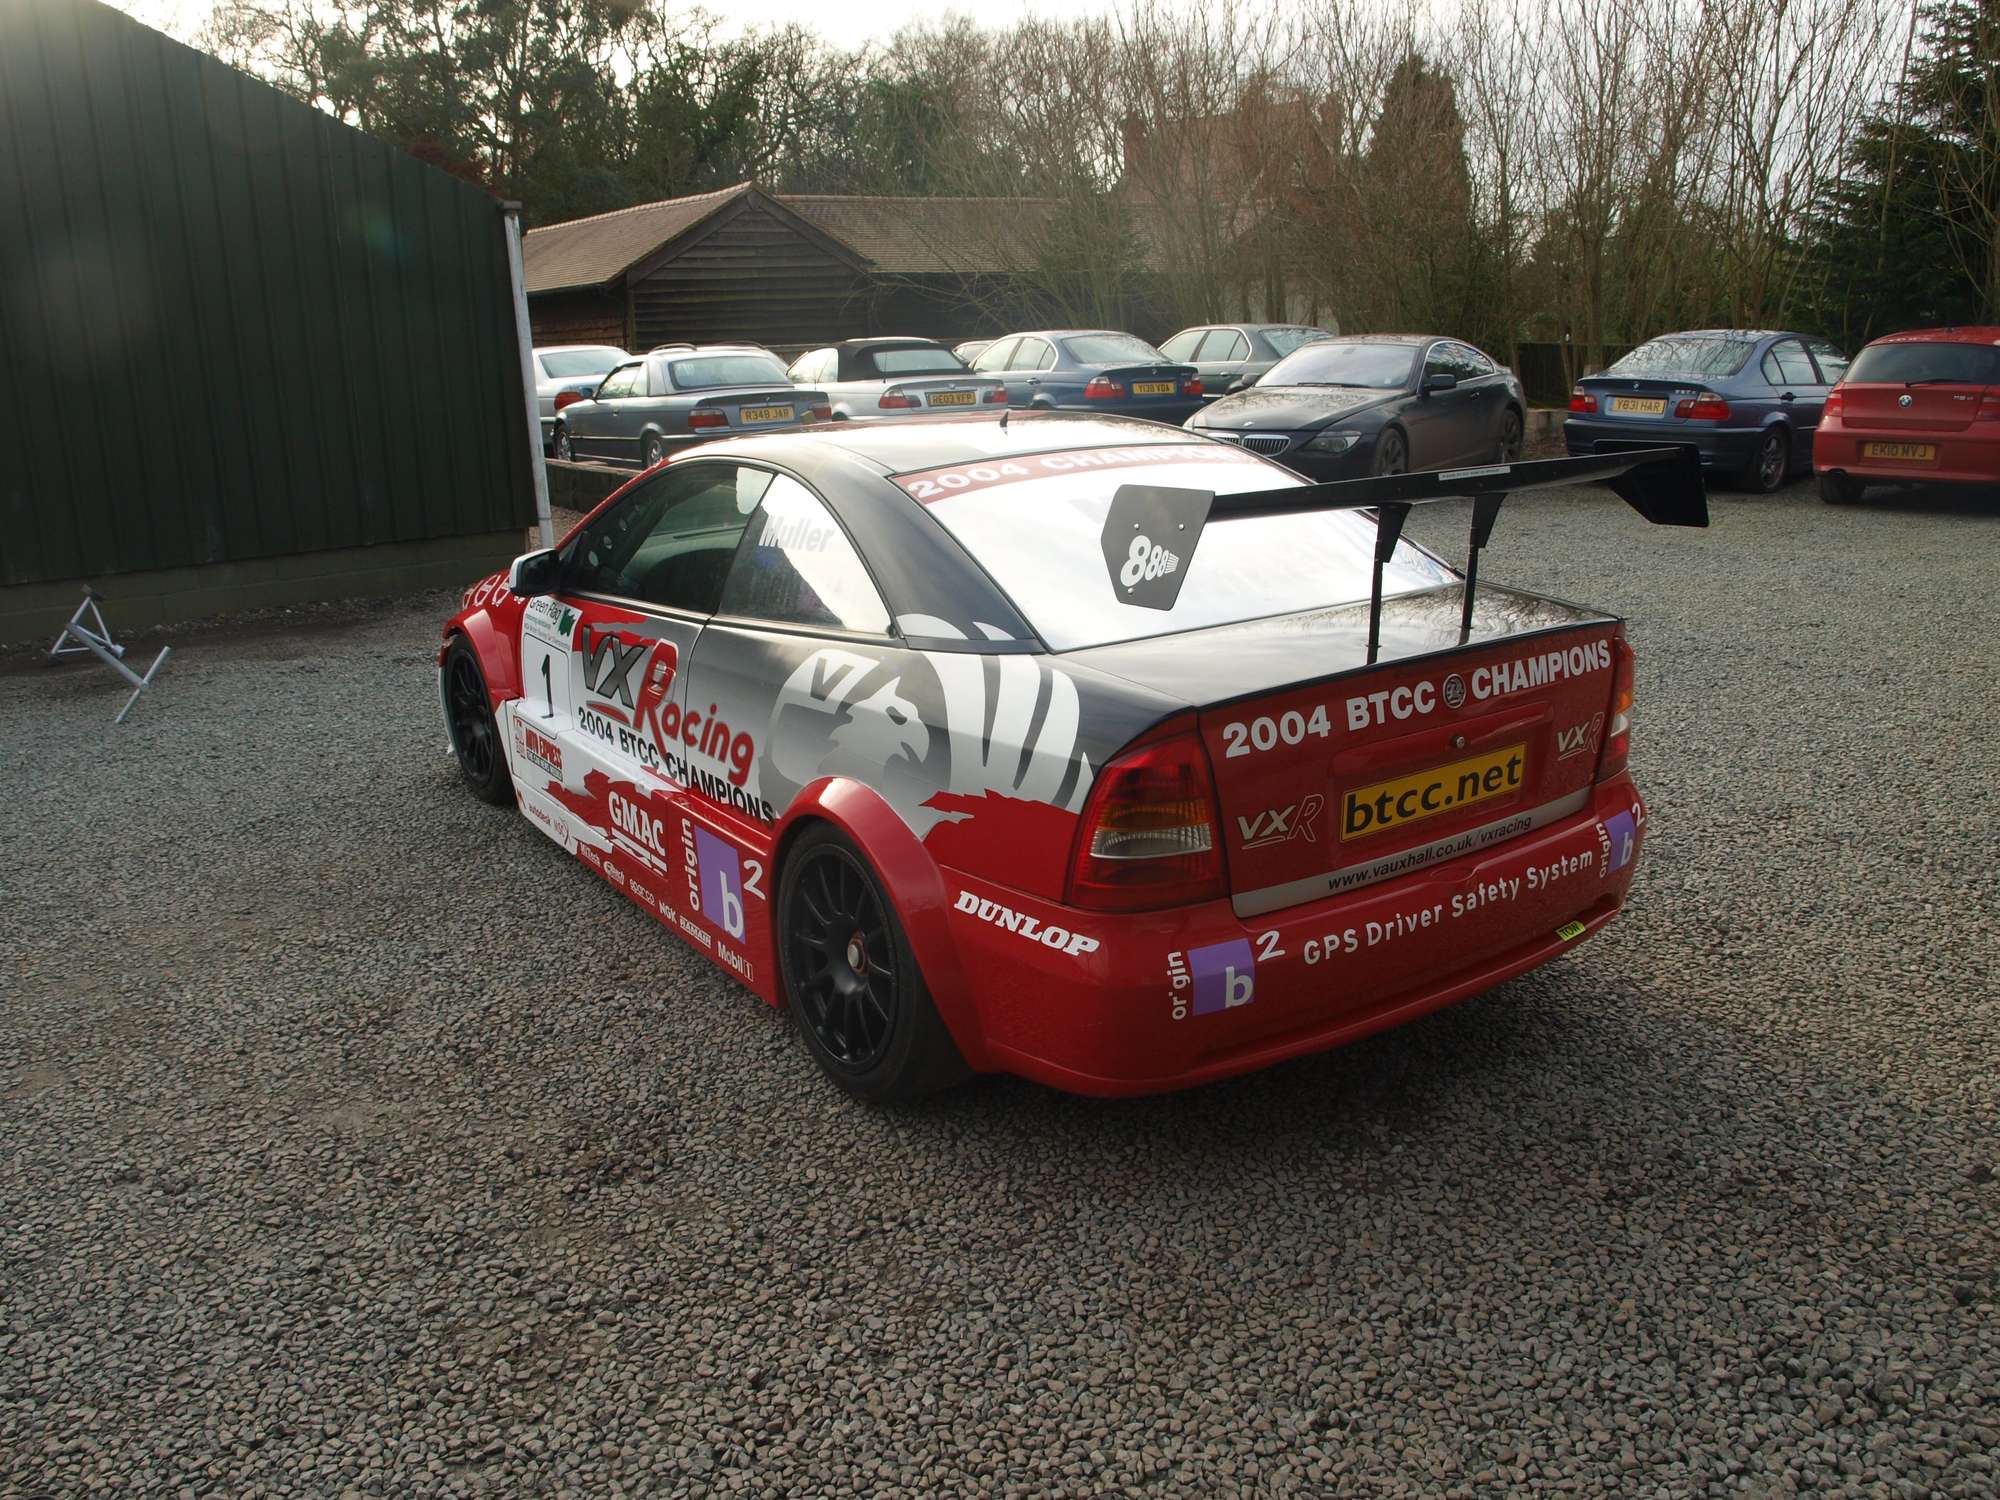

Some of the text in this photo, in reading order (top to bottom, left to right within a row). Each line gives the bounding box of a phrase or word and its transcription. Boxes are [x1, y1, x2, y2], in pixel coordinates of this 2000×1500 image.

[906, 461, 1029, 499] 2004
[540, 654, 554, 719] 1
[1222, 639, 1611, 759] 2004 BTCC CHAMPIONS
[578, 706, 615, 746] 2004
[619, 727, 660, 770] BTCC
[665, 752, 775, 826] CHAMPIONS
[1557, 711, 1605, 756] VXR
[608, 790, 667, 857] GMAC
[1237, 793, 1325, 844] VXR
[1345, 753, 1522, 834] btcc.net
[681, 818, 700, 911] origin
[658, 900, 678, 924] NGK
[717, 940, 744, 974] Mobil
[953, 889, 1101, 957] DUNLOP
[1303, 850, 1594, 965] GPS Driver Safety System
[1560, 921, 1582, 938] TOW
